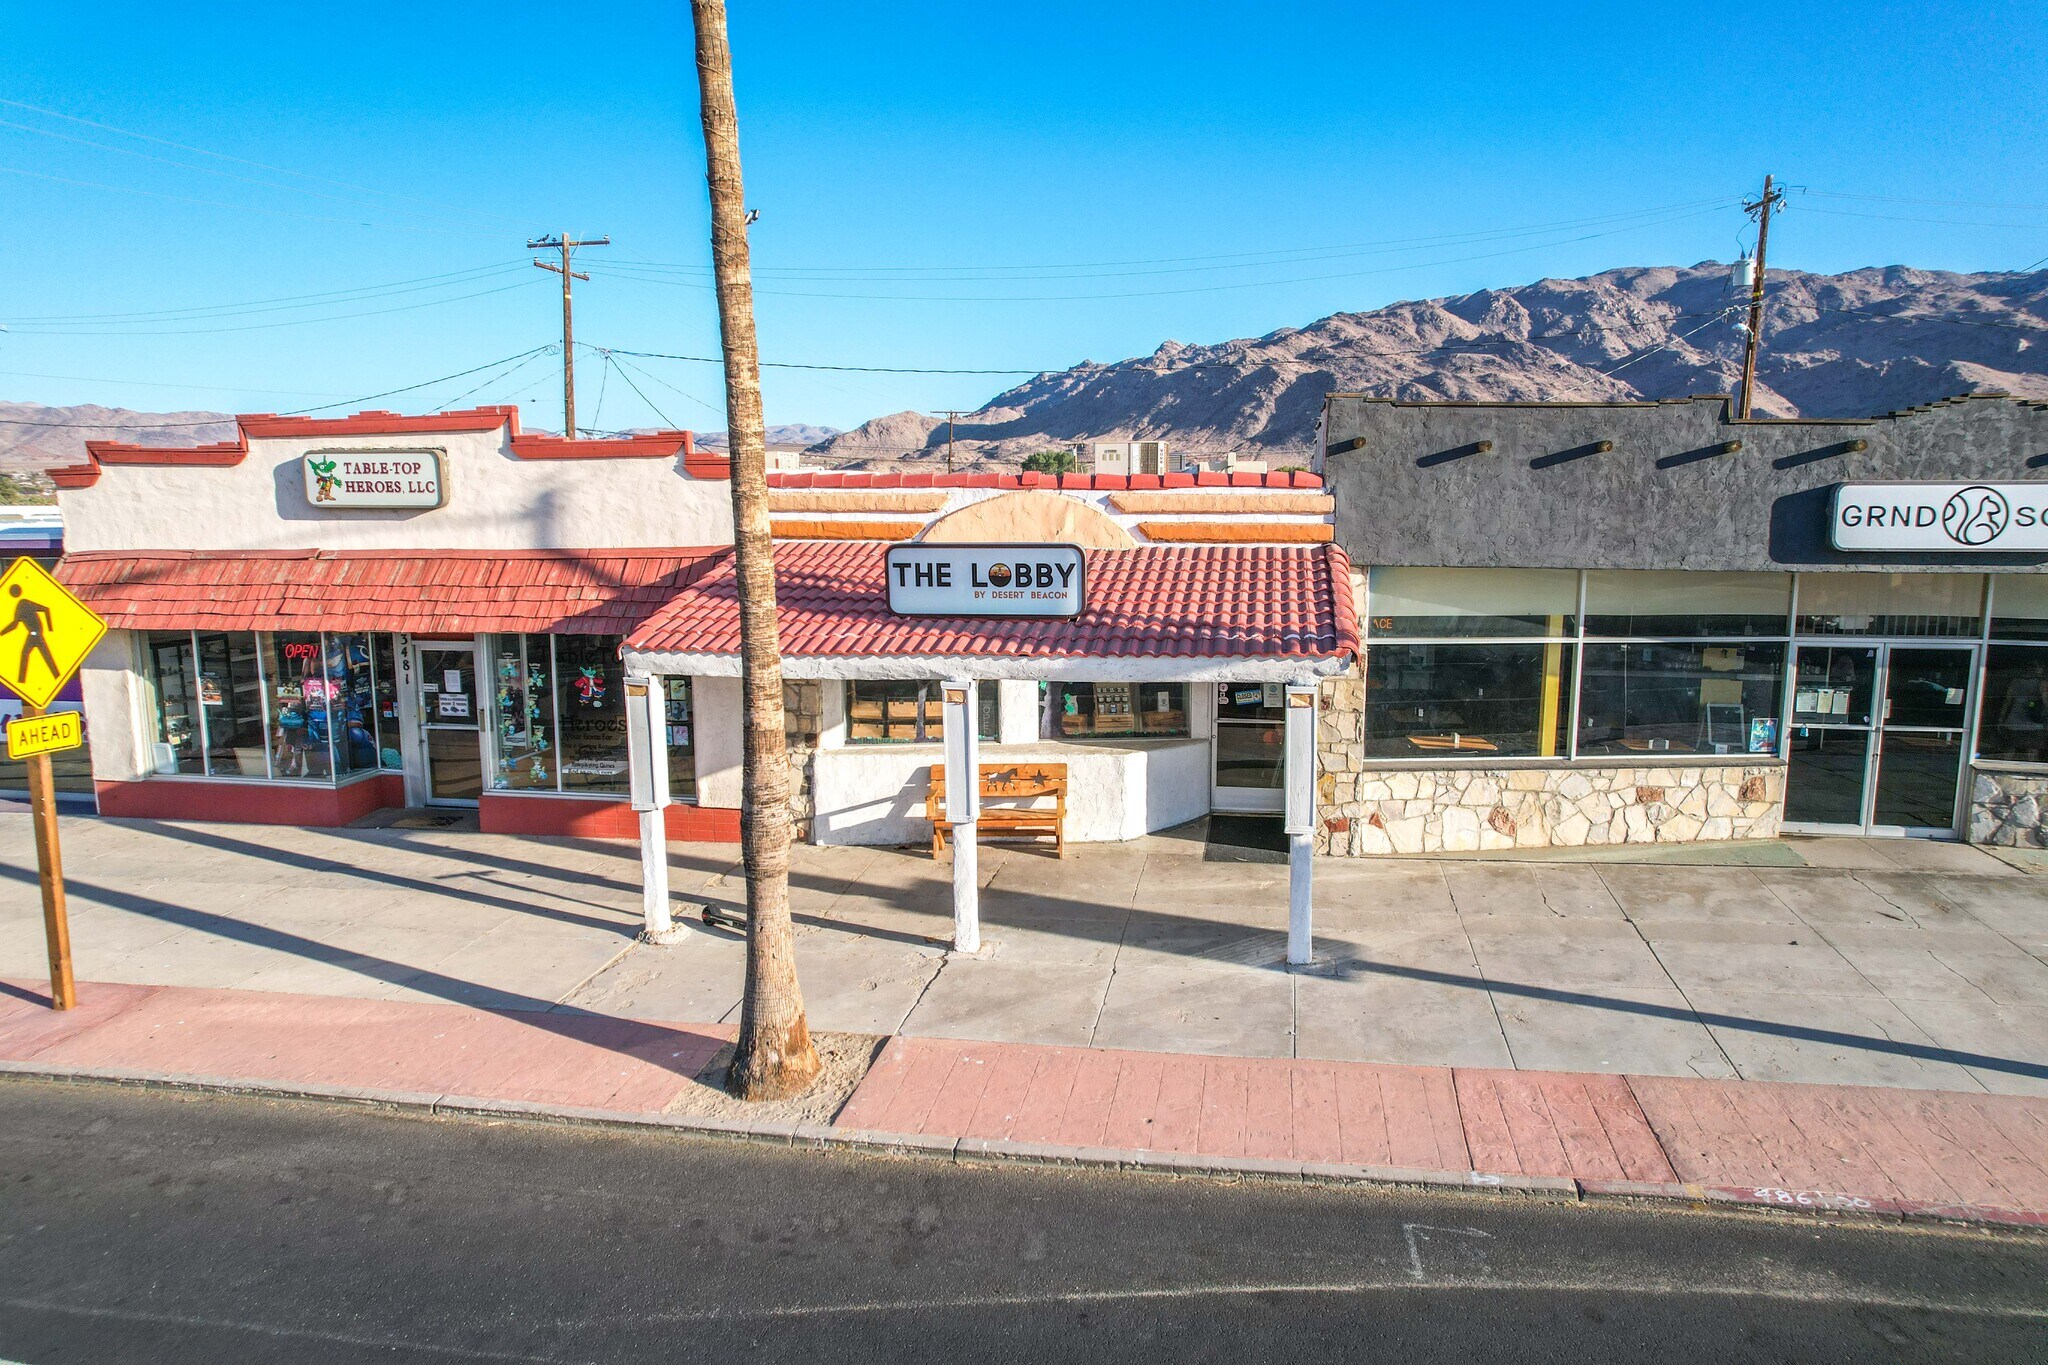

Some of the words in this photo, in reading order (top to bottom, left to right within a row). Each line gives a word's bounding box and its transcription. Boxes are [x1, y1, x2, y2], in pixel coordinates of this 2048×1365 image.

[344, 462, 421, 475] TABLE-TOP
[345, 481, 405, 494] HEROES,
[408, 481, 436, 493] LLC
[1841, 504, 1937, 527] GRND
[892, 563, 952, 588] THE
[971, 563, 1077, 588] LOBBY
[974, 591, 986, 599] BY
[991, 591, 1025, 599] DESERT
[1030, 592, 1068, 600] BEACON
[284, 643, 319, 659] OPEN
[400, 633, 410, 685] 3481
[559, 714, 627, 731] Heroes
[19, 723, 71, 746] AHEAD
